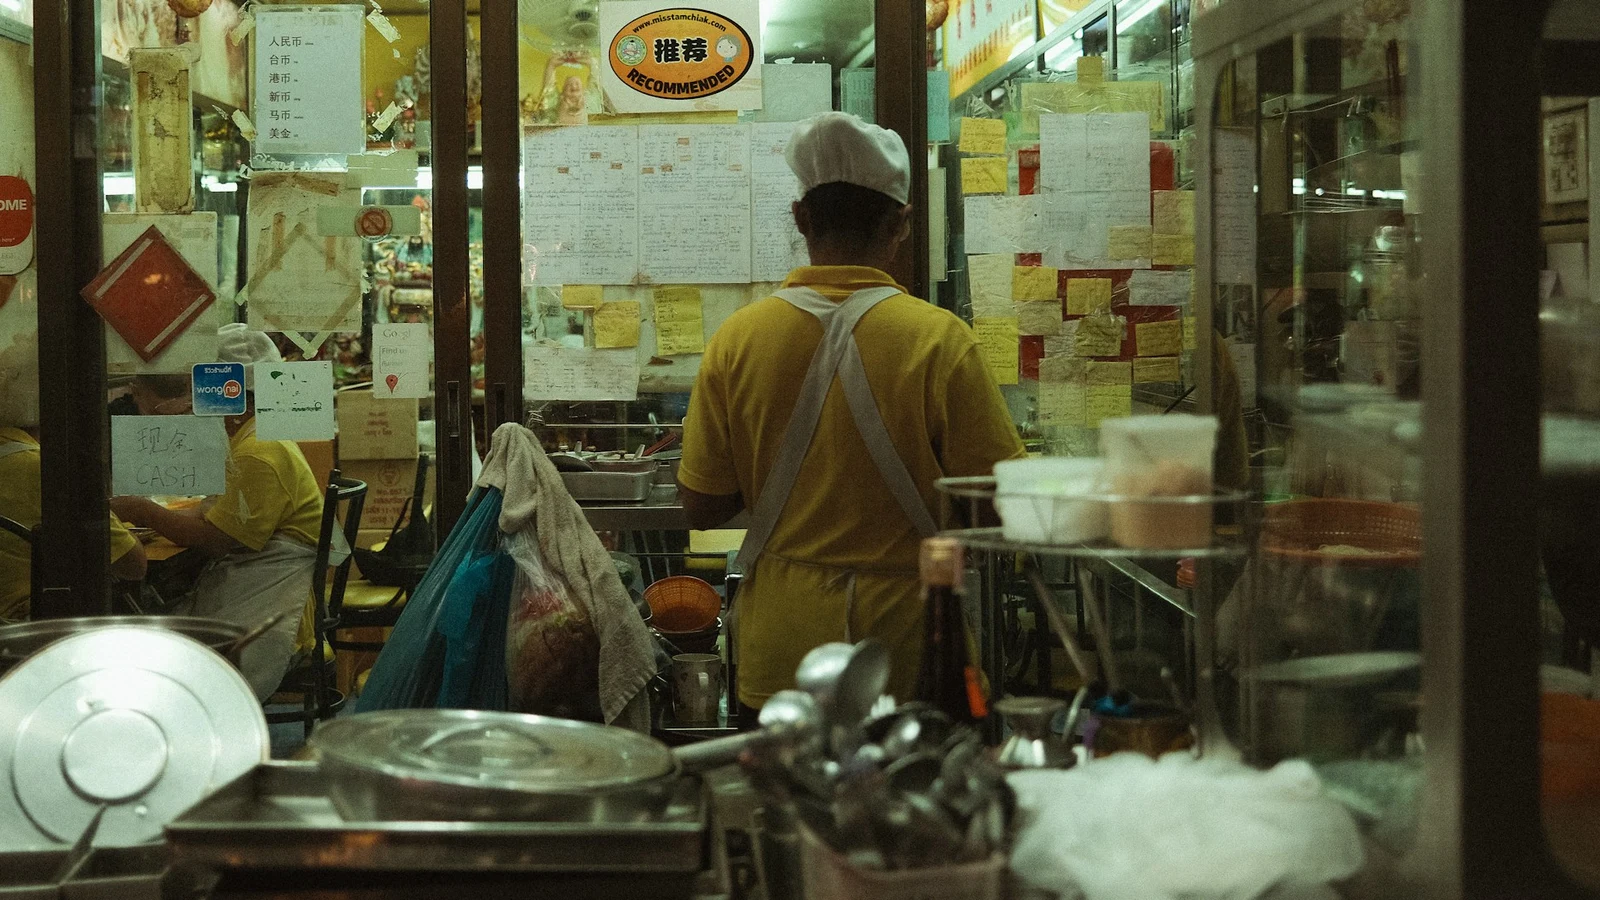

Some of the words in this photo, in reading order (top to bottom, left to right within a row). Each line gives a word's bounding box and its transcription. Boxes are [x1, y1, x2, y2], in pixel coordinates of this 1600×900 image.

[632, 13, 727, 34] www.misstamchiak.com
[269, 36, 302, 48] 人民币
[654, 37, 708, 64] 推荐
[269, 54, 291, 66] 台币
[269, 73, 291, 84] 港币
[626, 64, 736, 95] RECOMMENDED
[269, 91, 291, 103] 新币
[269, 110, 291, 121] 马币
[269, 128, 291, 140] 美金
[137, 426, 193, 459] 现金
[136, 463, 196, 488] CASH
